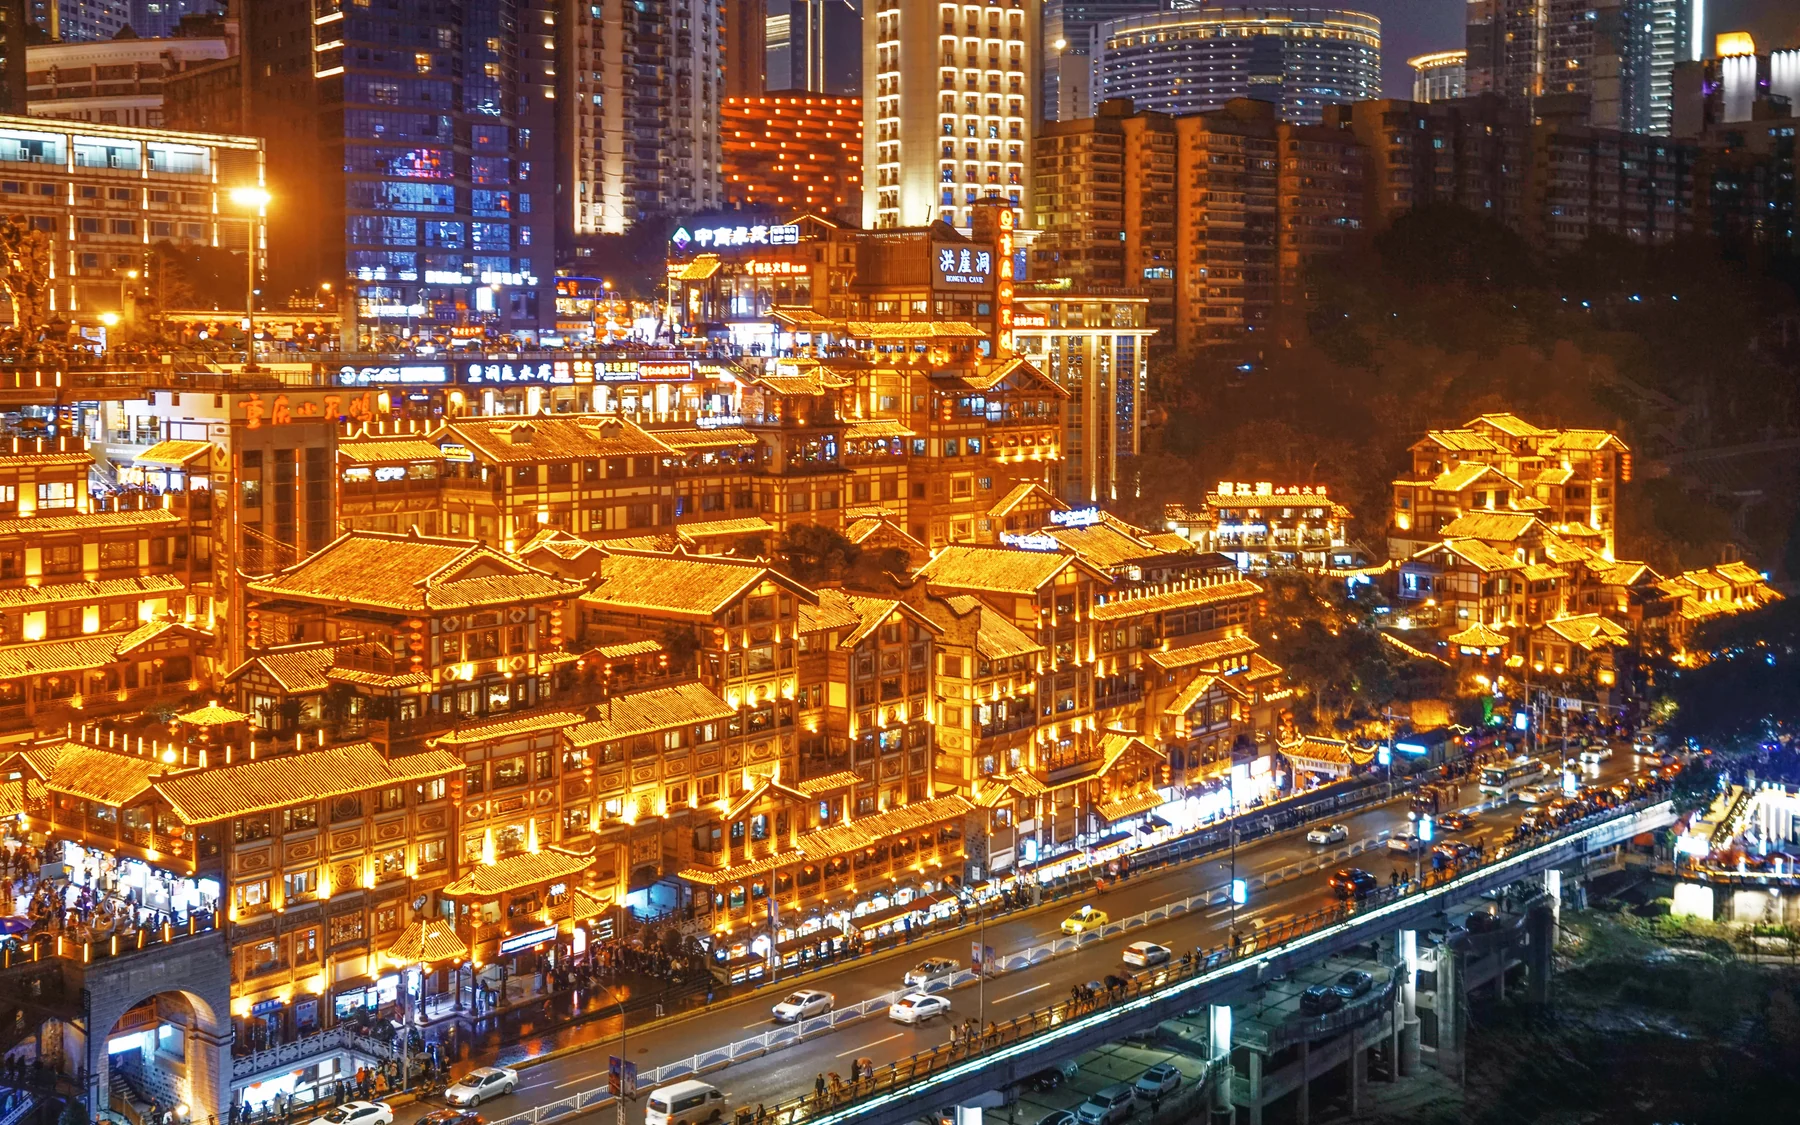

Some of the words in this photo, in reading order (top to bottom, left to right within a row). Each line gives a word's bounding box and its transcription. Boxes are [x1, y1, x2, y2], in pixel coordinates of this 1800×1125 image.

[939, 248, 990, 275] 洪崖洞
[238, 392, 373, 430] 重庆小天鹅
